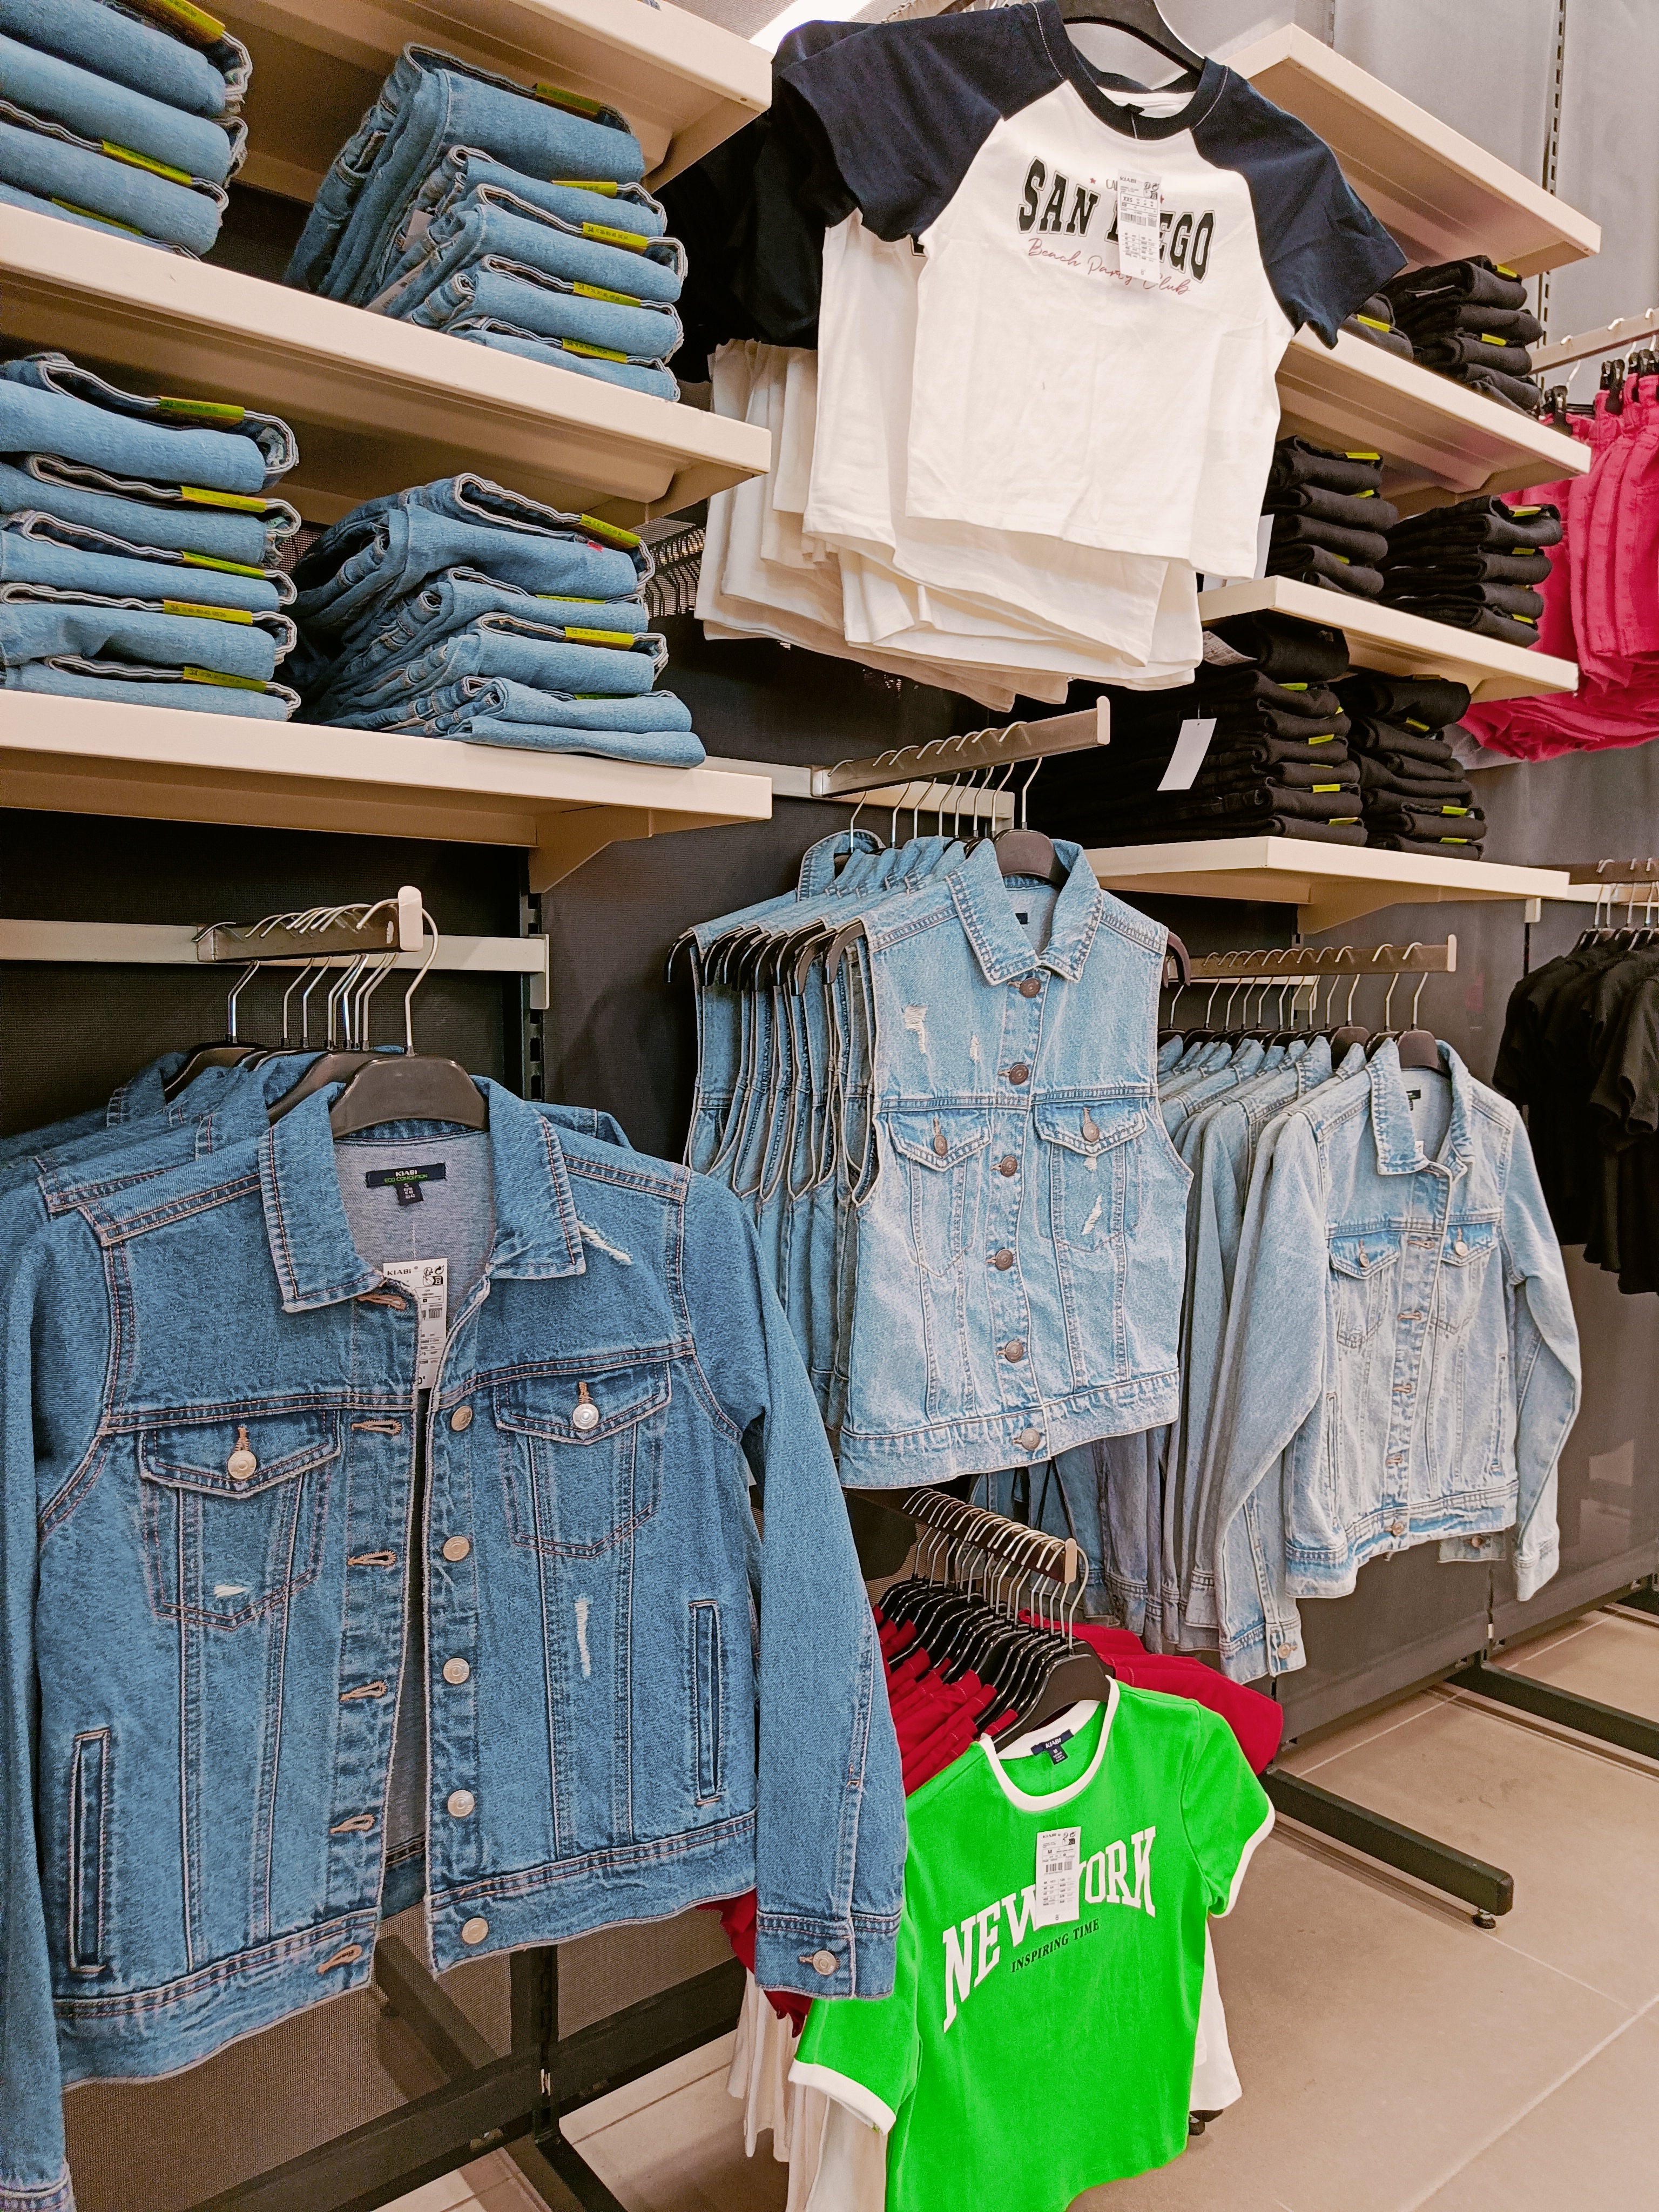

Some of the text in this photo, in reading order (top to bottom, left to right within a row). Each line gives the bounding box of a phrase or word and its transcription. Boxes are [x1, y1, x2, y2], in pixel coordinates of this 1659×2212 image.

[1017, 156, 1100, 237] SAN
[1028, 238, 1081, 266] Beach
[1045, 1737, 1062, 1749] KIABI
[942, 1825, 1156, 2033] NEW ORK
[1011, 1918, 1100, 1973] INSPIRING TIME
